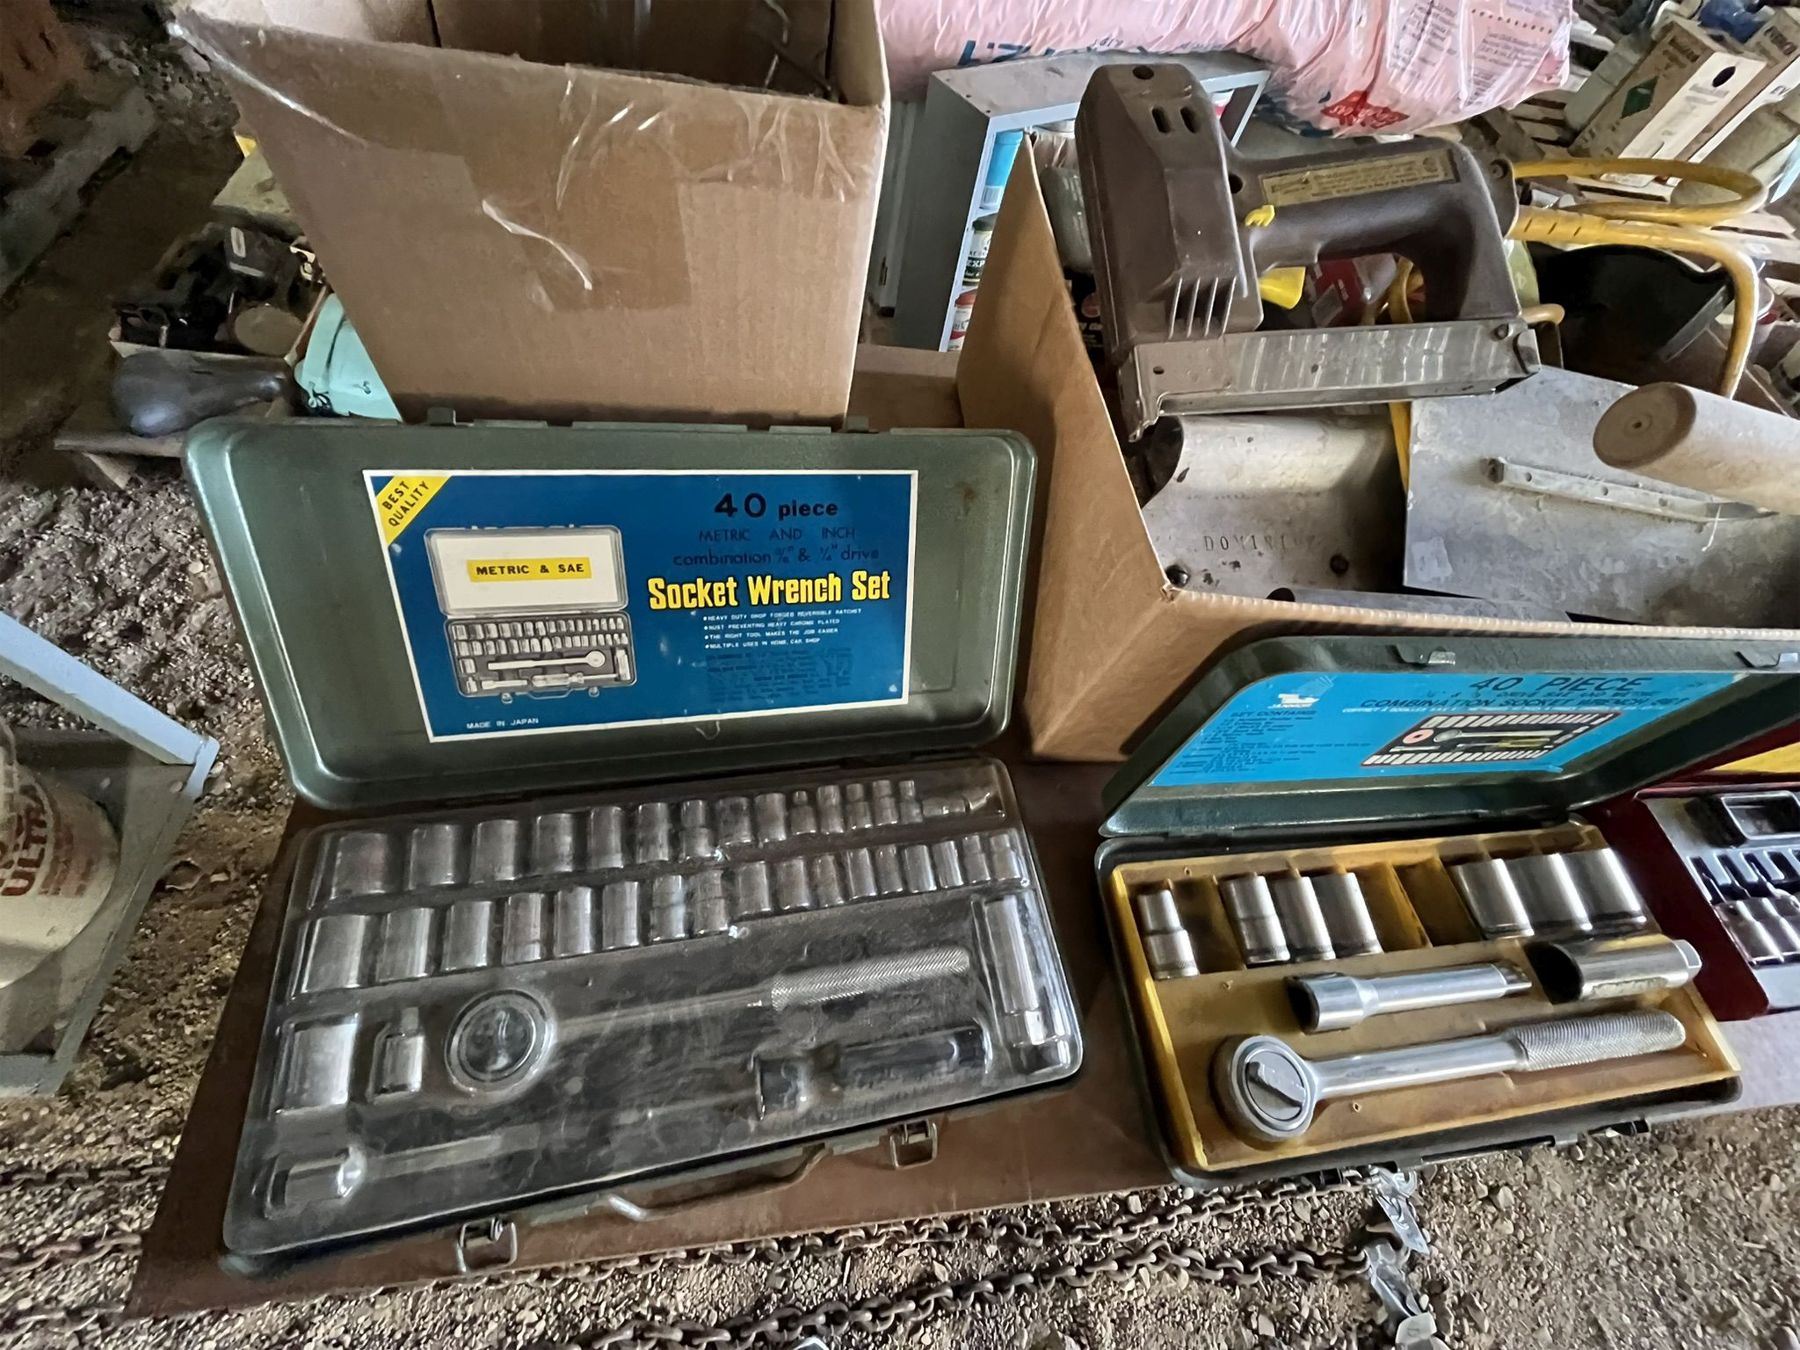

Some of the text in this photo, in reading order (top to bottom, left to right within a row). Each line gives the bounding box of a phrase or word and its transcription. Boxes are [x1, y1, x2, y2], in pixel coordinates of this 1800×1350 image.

[382, 481, 410, 510] BEST
[388, 481, 429, 527] QUALITY
[714, 492, 838, 521] 40 piece
[699, 526, 856, 542] METRIC AND INCH
[672, 549, 772, 566] combination
[797, 549, 811, 562] &
[841, 545, 880, 561] drive
[476, 563, 584, 575] METRIC & SAE
[648, 570, 891, 610] Socket Wrench Set
[728, 622, 765, 630] PREVENTING
[709, 641, 740, 649] MULTIPLE
[1469, 677, 1652, 691] 40 PIECE
[1360, 699, 1497, 708] COMBINATION
[1496, 698, 1570, 707] SOCKET
[466, 720, 491, 729] MADE
[510, 717, 539, 726] JAPAN
